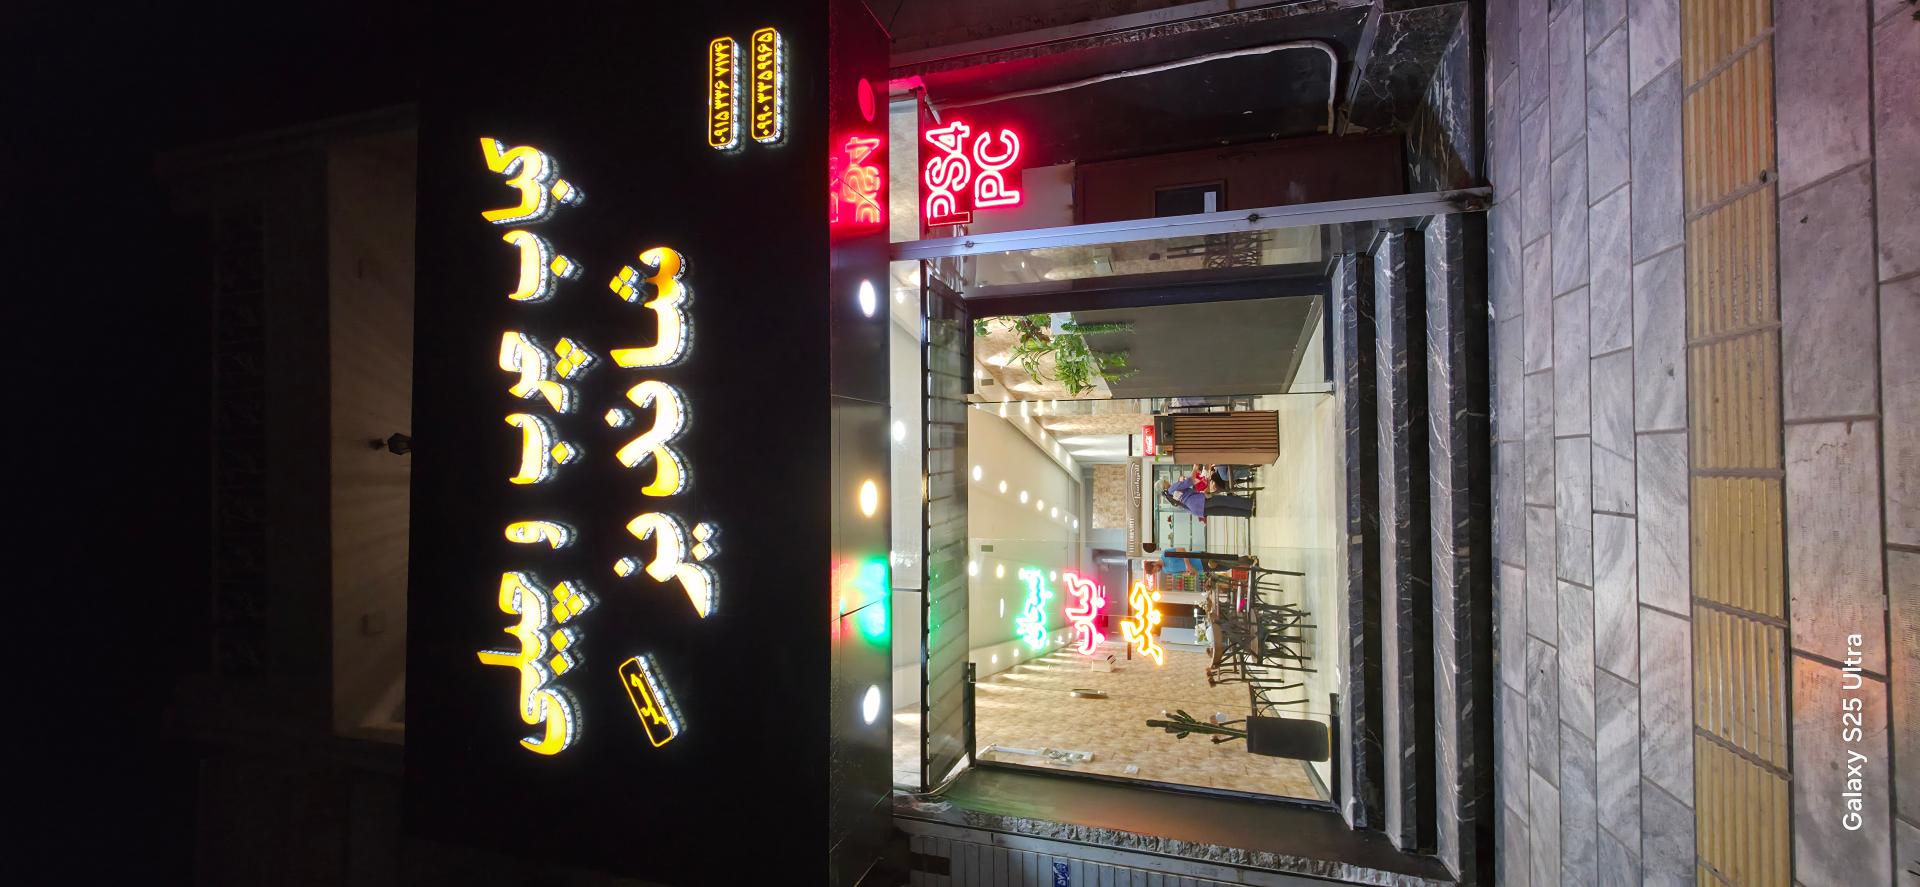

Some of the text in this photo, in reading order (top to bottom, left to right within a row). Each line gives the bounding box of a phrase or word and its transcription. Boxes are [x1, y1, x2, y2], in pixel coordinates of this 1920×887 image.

[924, 120, 971, 227] PS4
[972, 128, 1021, 209] PC
[477, 137, 593, 755] کباب چرب و چیلی
[604, 247, 716, 619] شاندیز
[1062, 572, 1106, 656] کباب
[1120, 581, 1164, 666] جیگر
